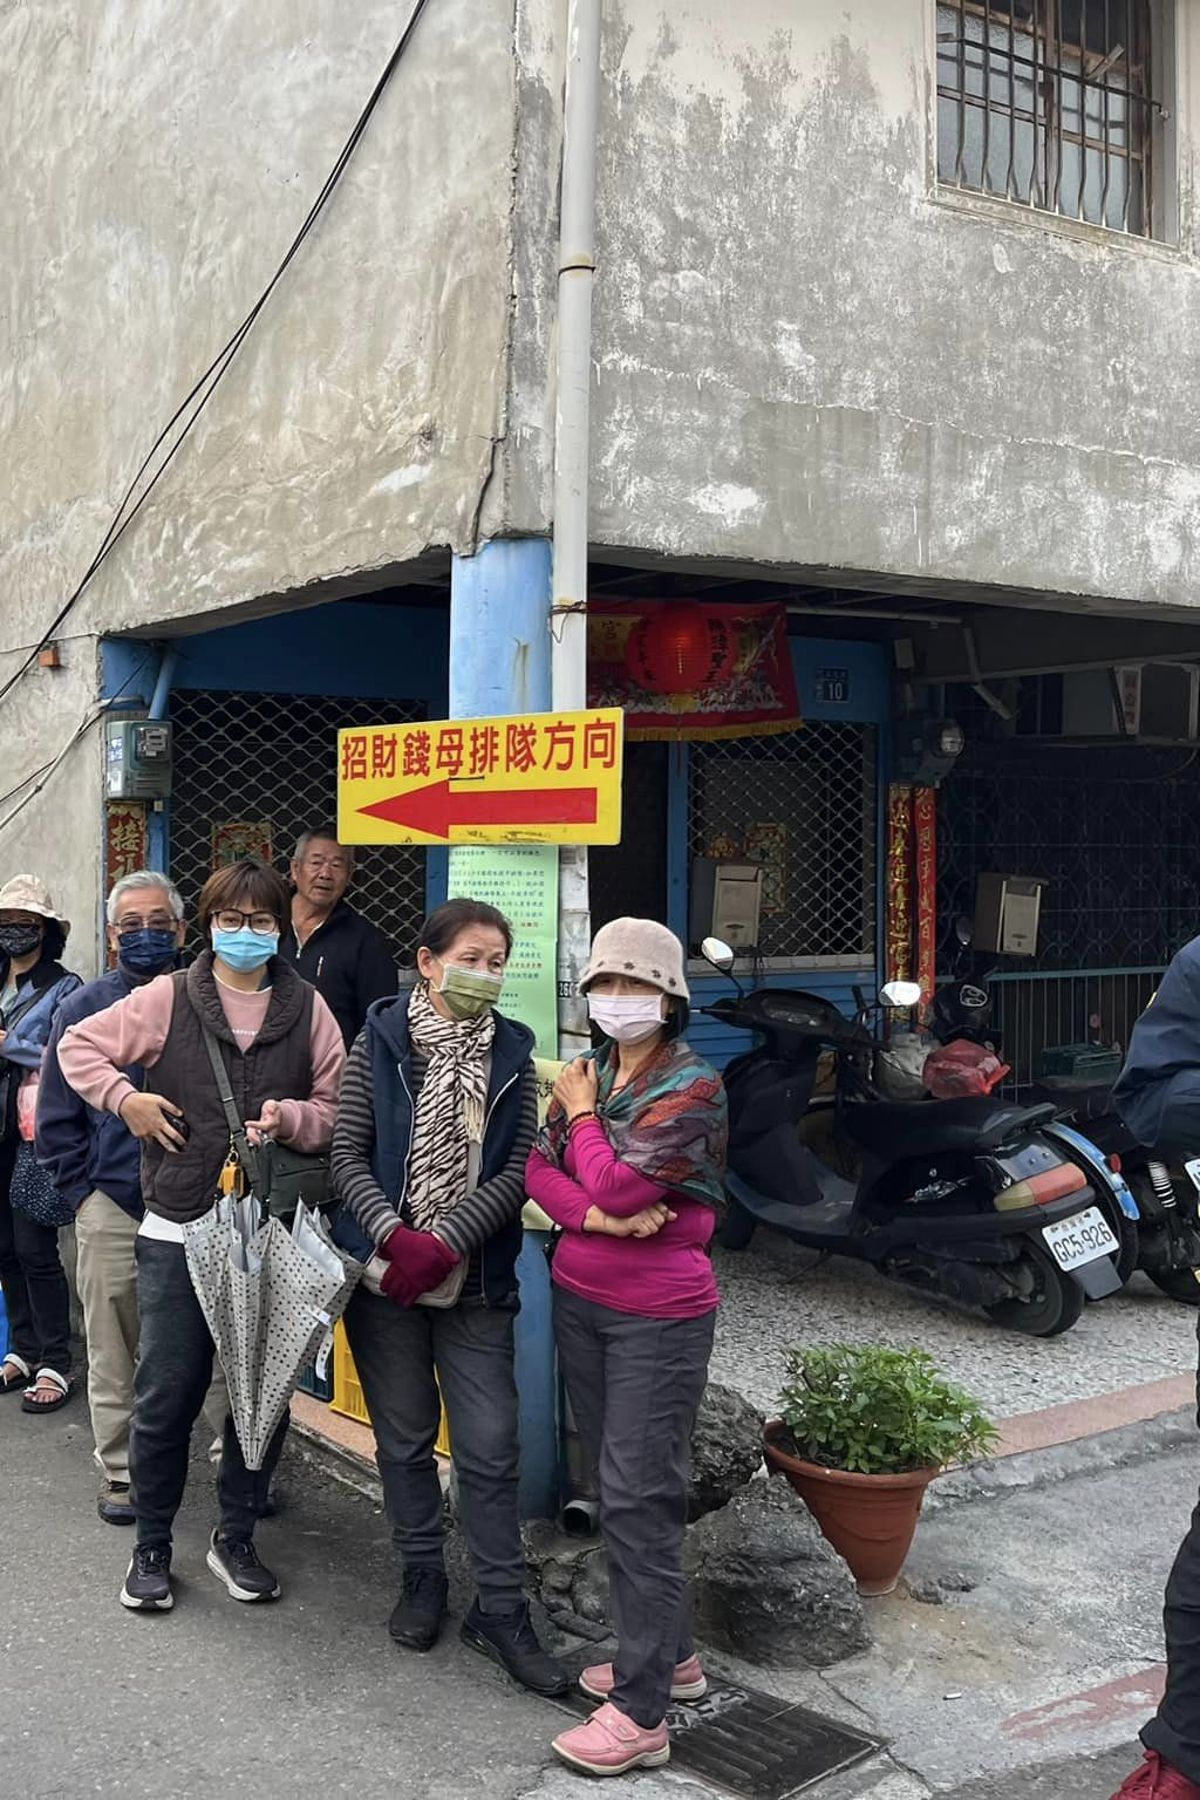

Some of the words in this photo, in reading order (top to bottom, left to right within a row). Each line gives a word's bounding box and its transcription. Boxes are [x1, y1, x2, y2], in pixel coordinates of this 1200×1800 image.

[828, 682, 843, 700] 10
[341, 717, 616, 781] 招財錢母排隊方向
